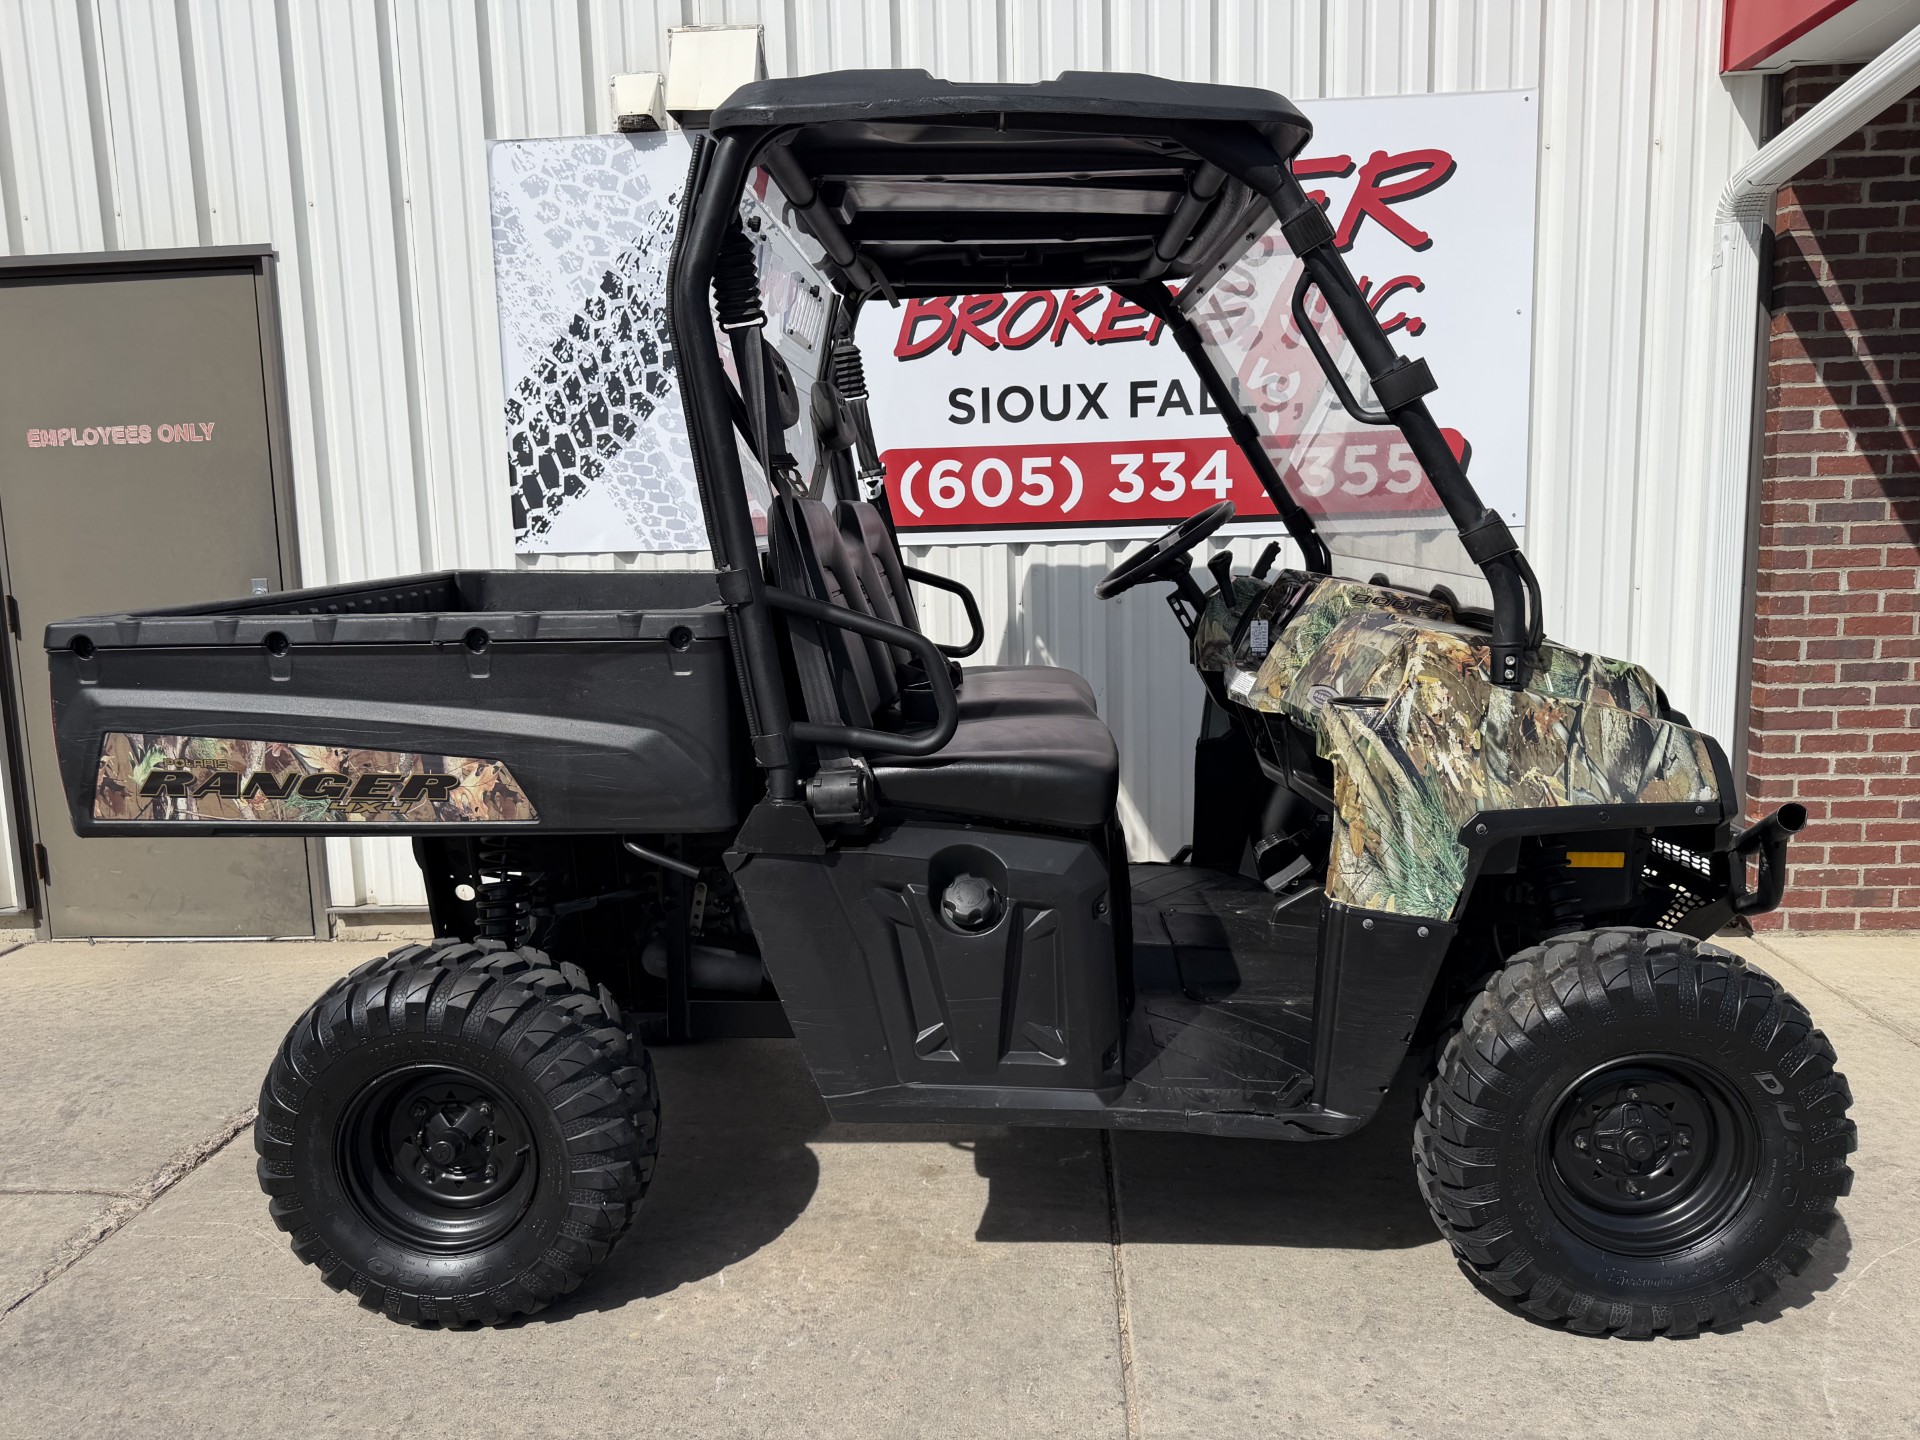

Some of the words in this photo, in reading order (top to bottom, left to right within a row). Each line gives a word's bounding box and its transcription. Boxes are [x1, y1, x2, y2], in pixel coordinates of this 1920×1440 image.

[948, 382, 1109, 425] SIOUX
[27, 425, 152, 448] EMPLOYEES
[157, 422, 215, 442] ONLY
[900, 455, 1084, 518] (605)
[1109, 449, 1233, 503] 334
[163, 759, 228, 768] POLARIS
[139, 771, 461, 800] RANGER
